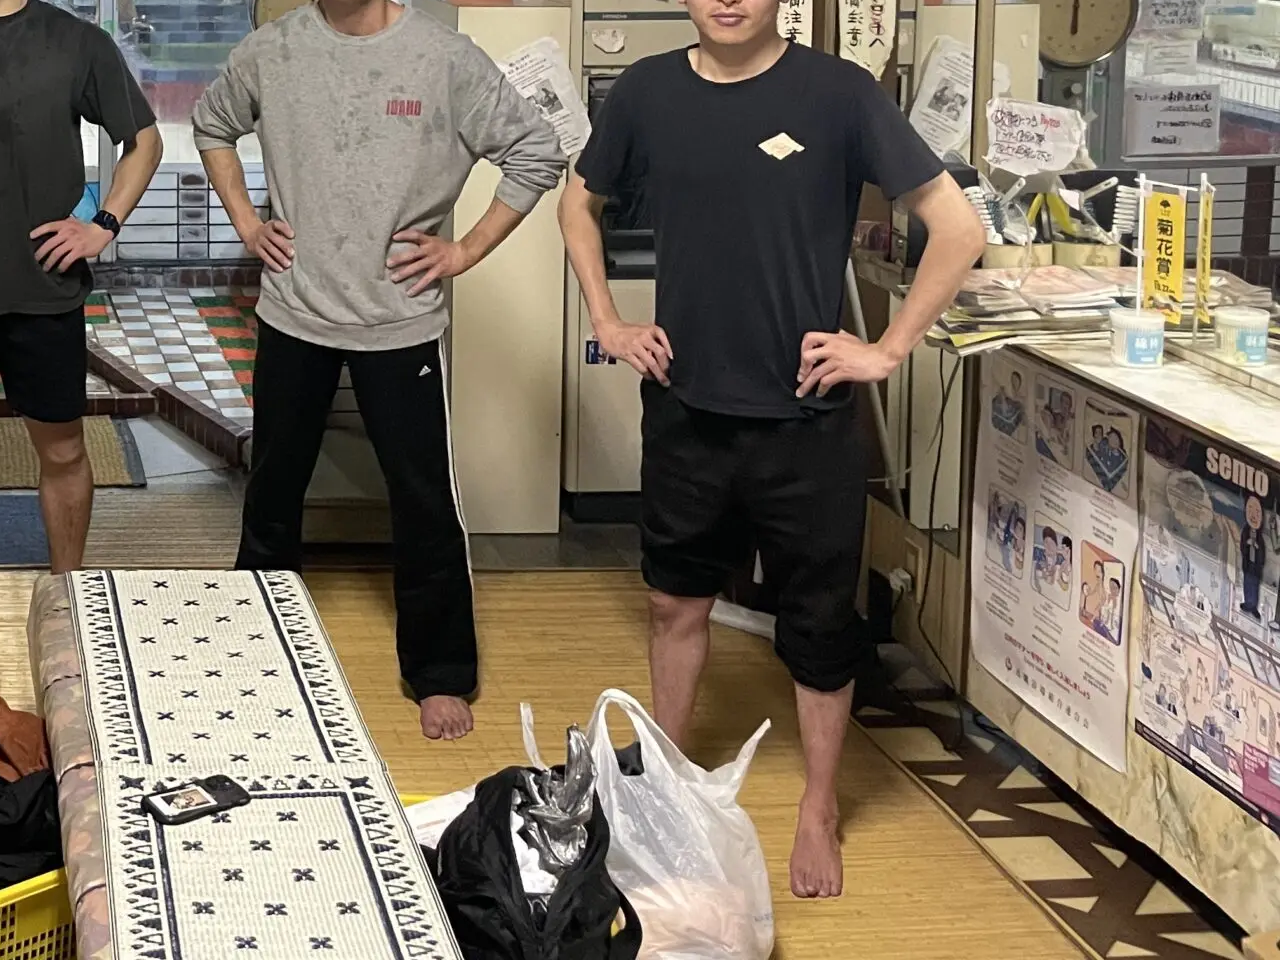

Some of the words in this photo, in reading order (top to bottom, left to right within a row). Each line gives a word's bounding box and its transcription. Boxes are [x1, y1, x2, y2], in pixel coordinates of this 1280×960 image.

[386, 99, 422, 117] IDAHO
[1156, 218, 1174, 278] 菊花賞
[1205, 444, 1269, 499] sento
